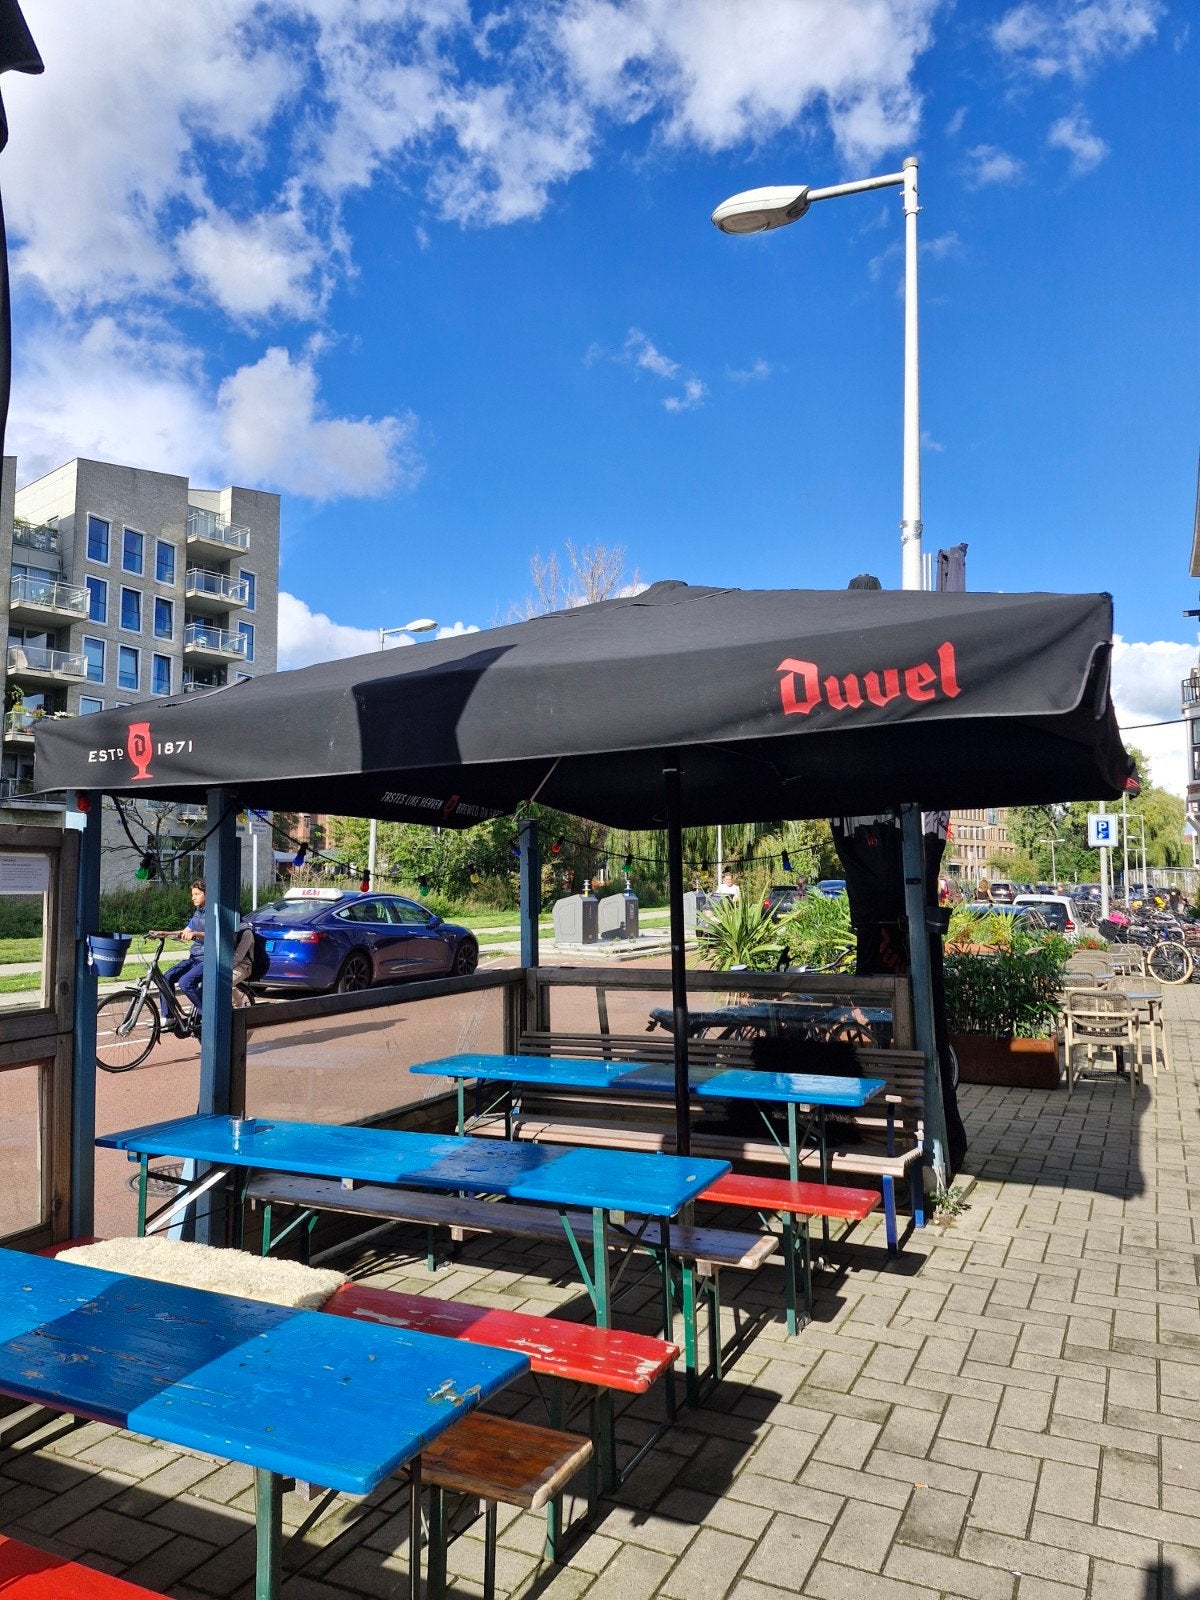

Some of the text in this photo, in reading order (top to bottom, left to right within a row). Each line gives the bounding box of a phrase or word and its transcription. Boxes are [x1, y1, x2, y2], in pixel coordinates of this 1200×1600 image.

[775, 641, 962, 716] Duvel
[157, 740, 193, 756] 1871
[381, 791, 407, 804] TASTES
[404, 795, 421, 806] LIKE
